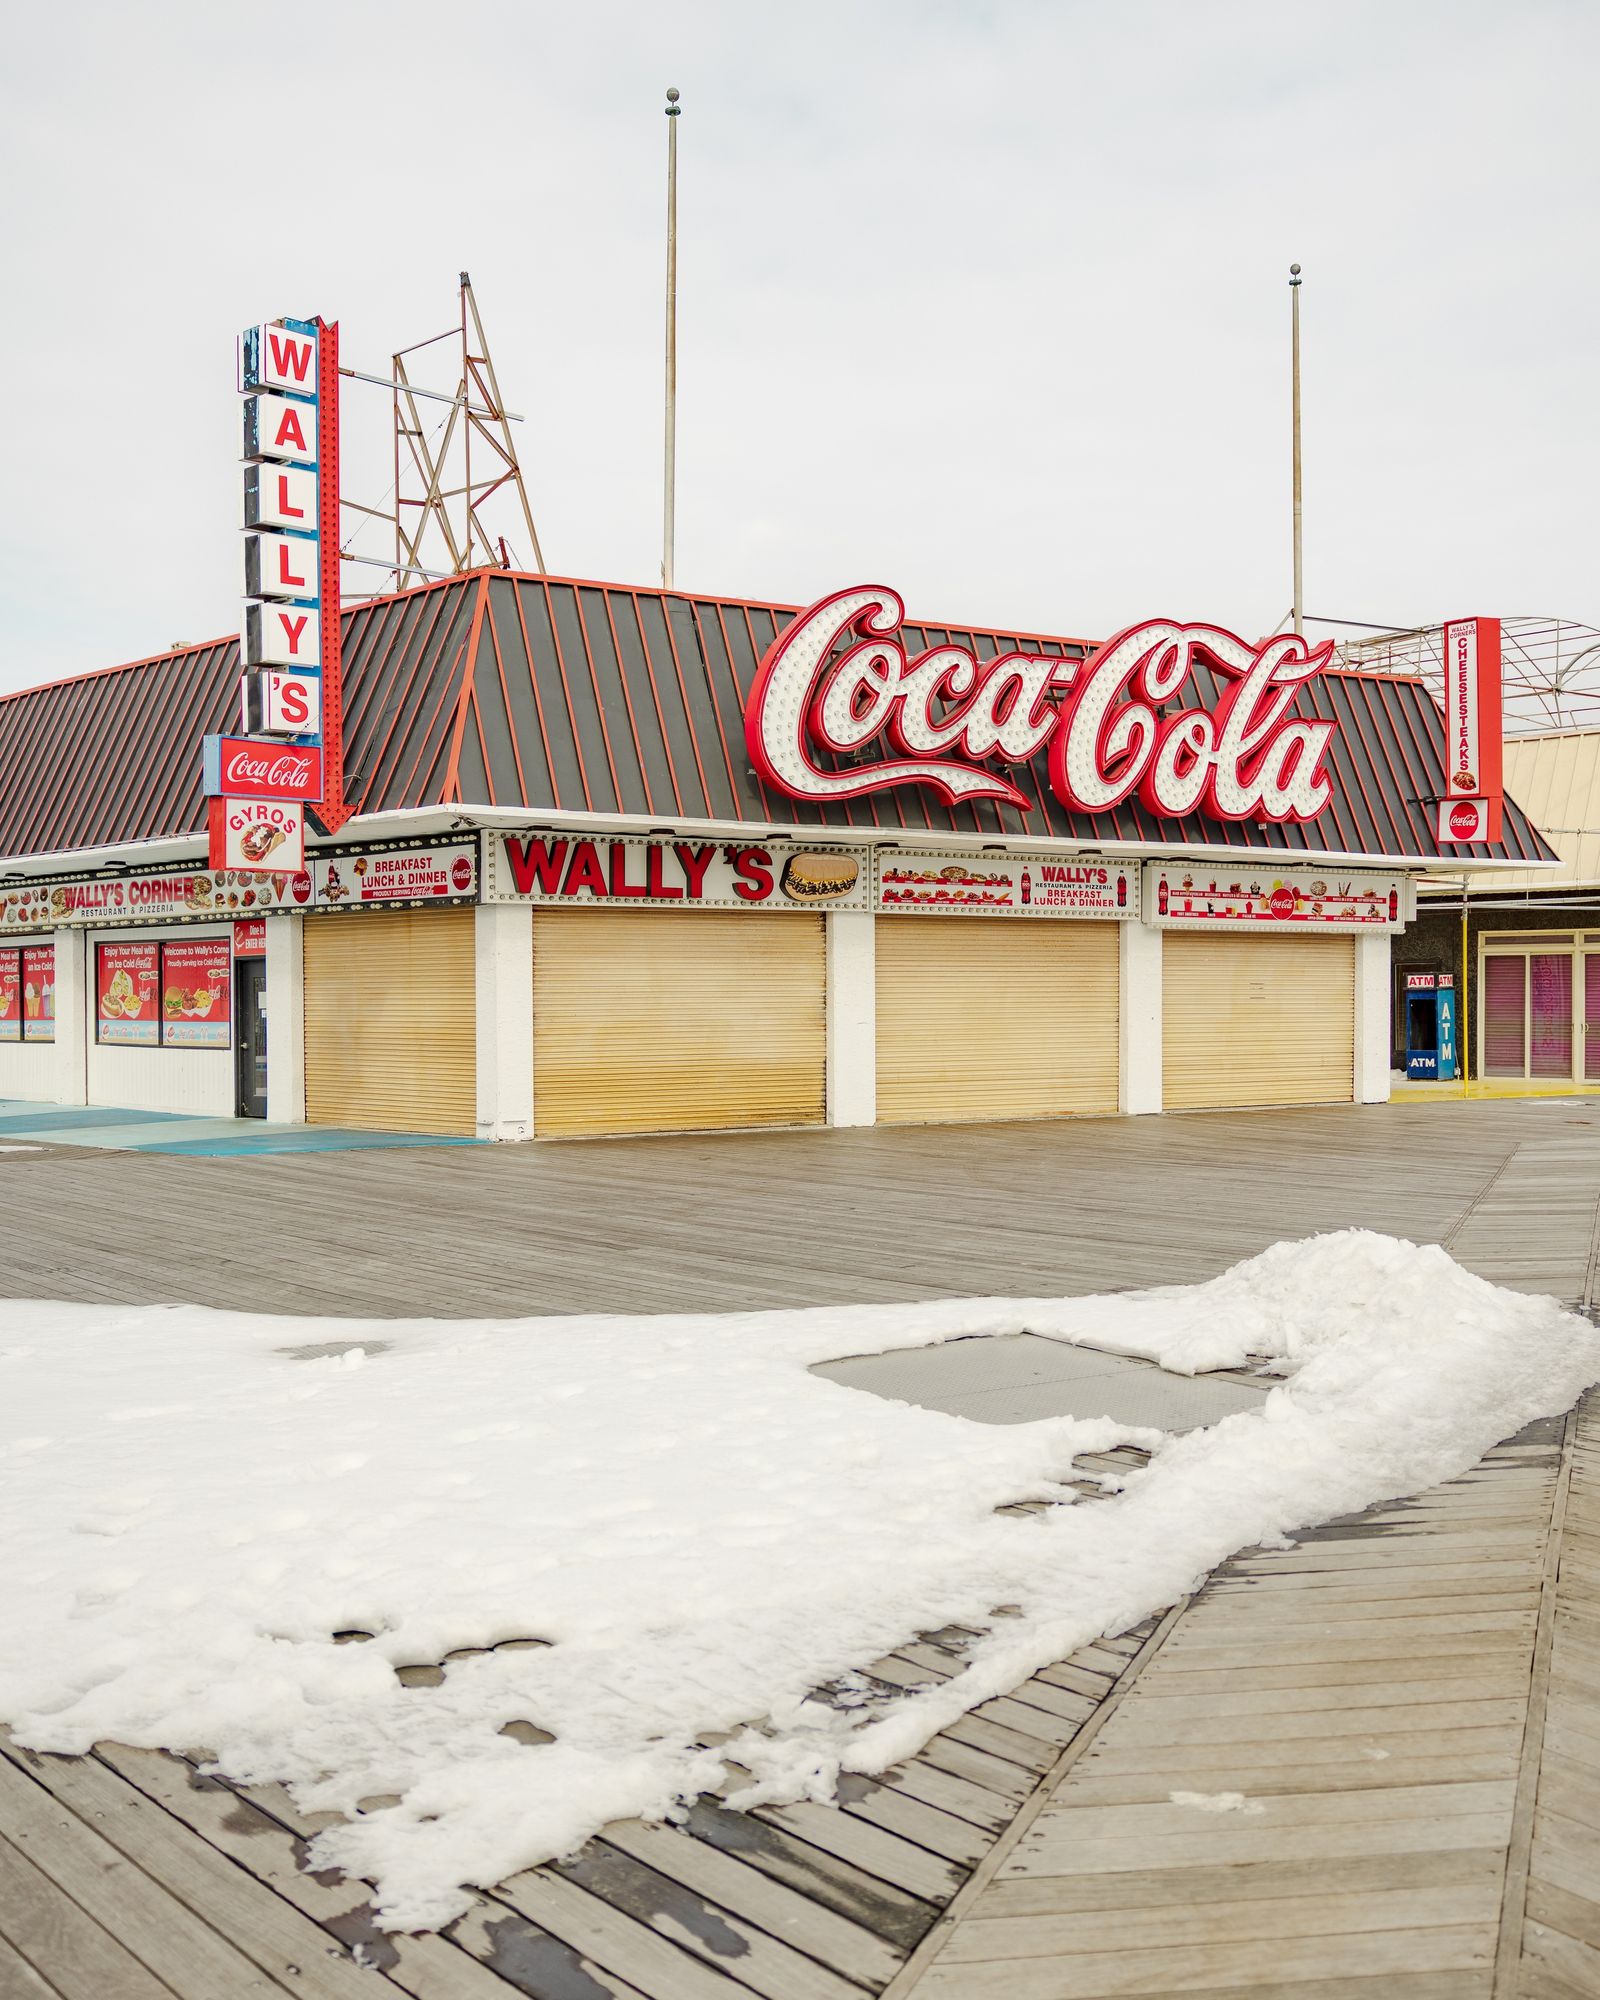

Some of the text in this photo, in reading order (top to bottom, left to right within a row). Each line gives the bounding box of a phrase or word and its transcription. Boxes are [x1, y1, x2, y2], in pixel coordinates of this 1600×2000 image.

[268, 333, 313, 724] WALLY'S
[1458, 637, 1469, 771] CHEESESTEAKS
[229, 805, 296, 834] GYROS
[375, 857, 432, 872] BREAKFAST
[503, 838, 774, 901] WALLY'S
[362, 871, 447, 888] LUNCH & DINNER
[1041, 866, 1107, 884] WALLY'S
[63, 877, 196, 909] WALLY'S CORNER
[1047, 889, 1102, 899] BREAKFAST
[81, 907, 127, 917] RESTAURANT
[140, 904, 174, 914] PIZZERIA
[1034, 897, 1114, 907] LUNCH & DINNER
[1409, 976, 1434, 986] ATM
[1438, 976, 1453, 986] ATM
[1441, 1002, 1452, 1060] ATM
[1410, 1057, 1435, 1068] ATM
